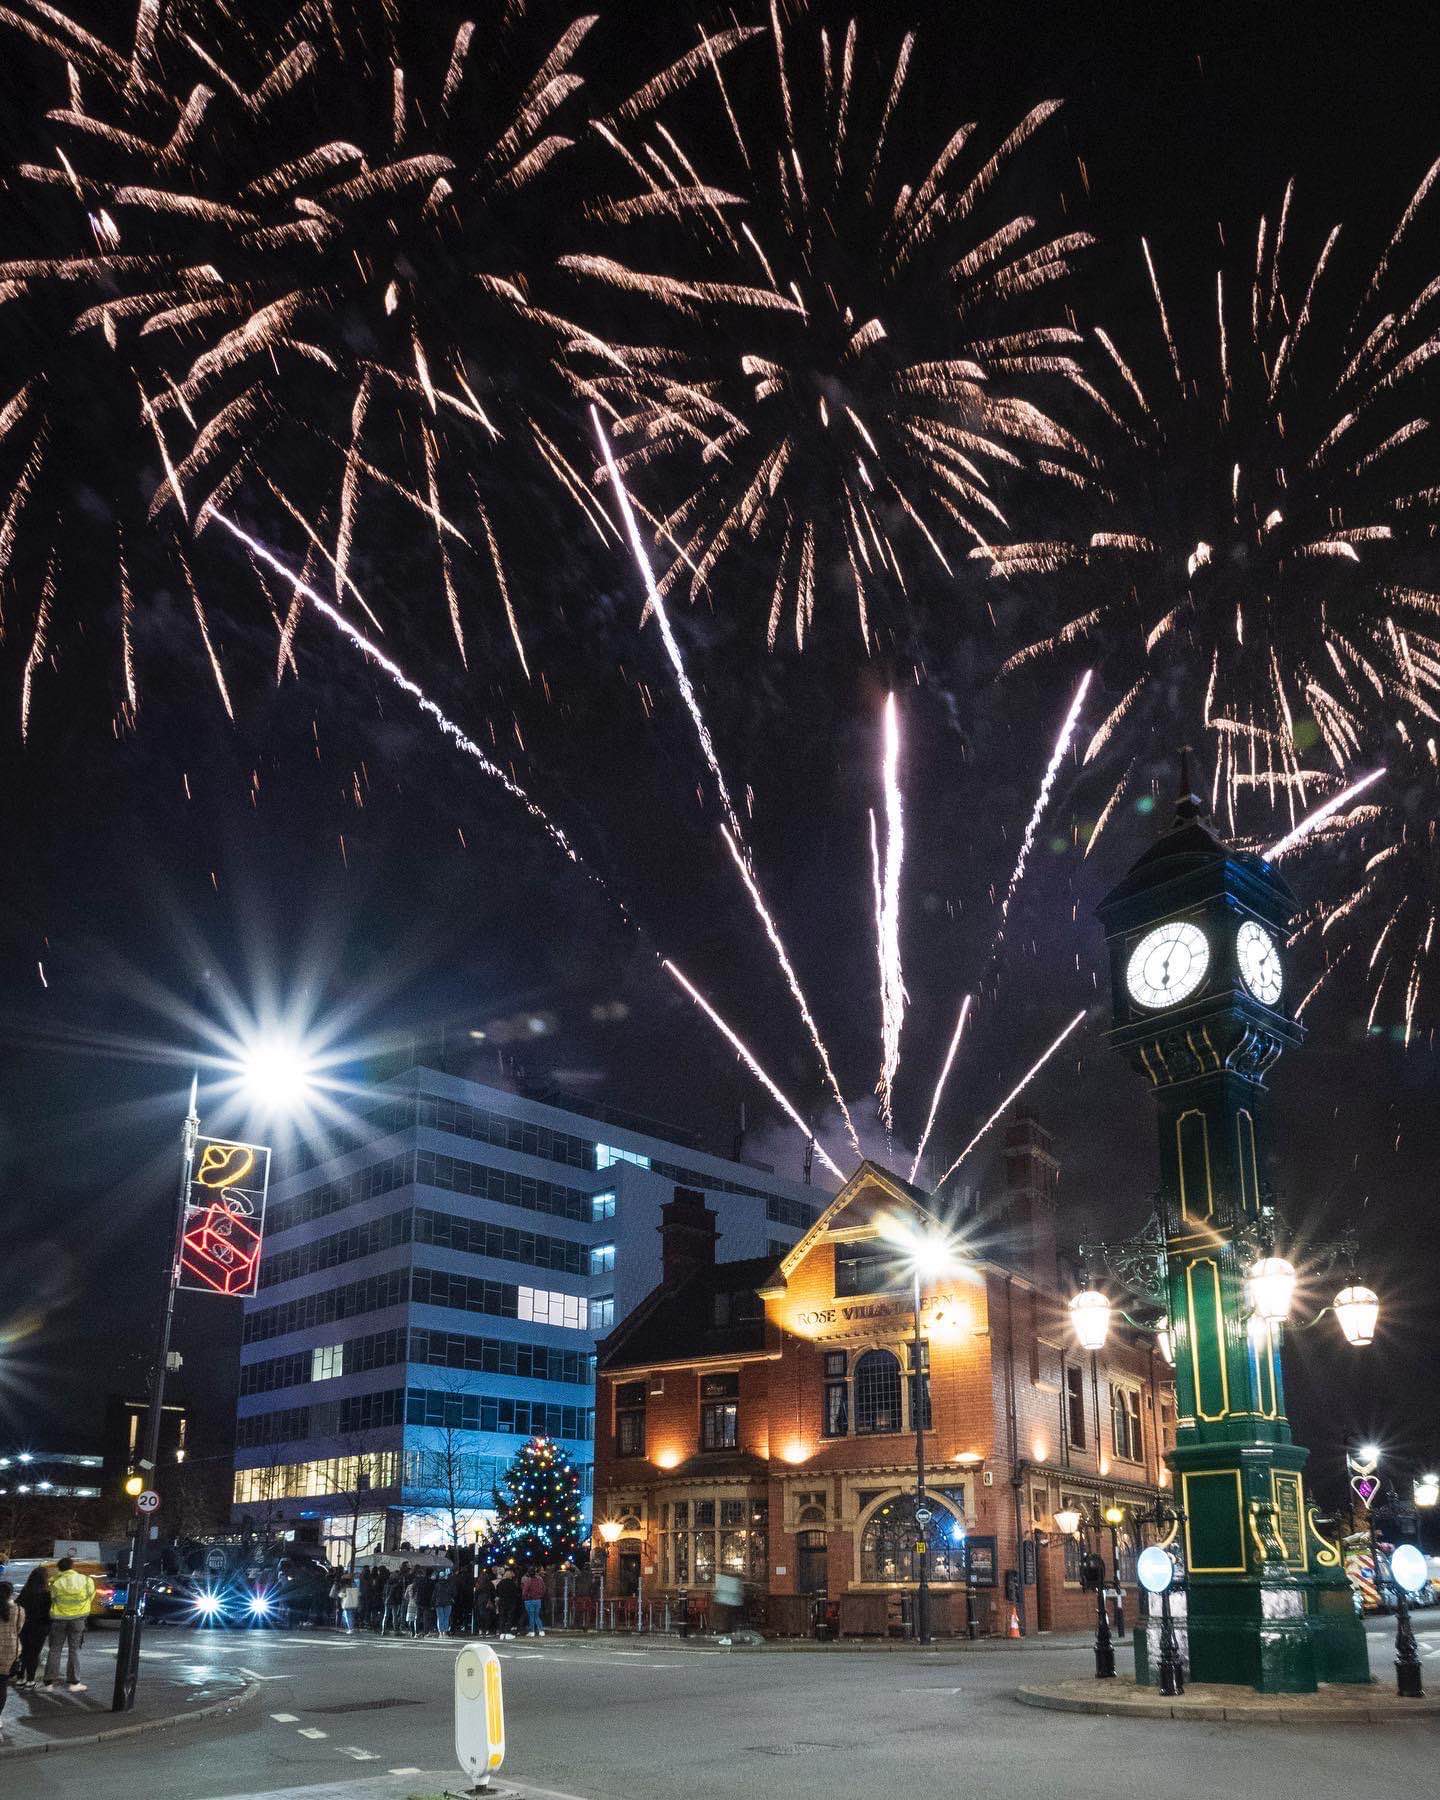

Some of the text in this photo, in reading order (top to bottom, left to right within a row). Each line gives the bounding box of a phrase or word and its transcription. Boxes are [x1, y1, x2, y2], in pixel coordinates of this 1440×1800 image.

[798, 1310, 837, 1326] ROSE
[893, 1295, 953, 1317] TAERN
[139, 1495, 157, 1506] 20
